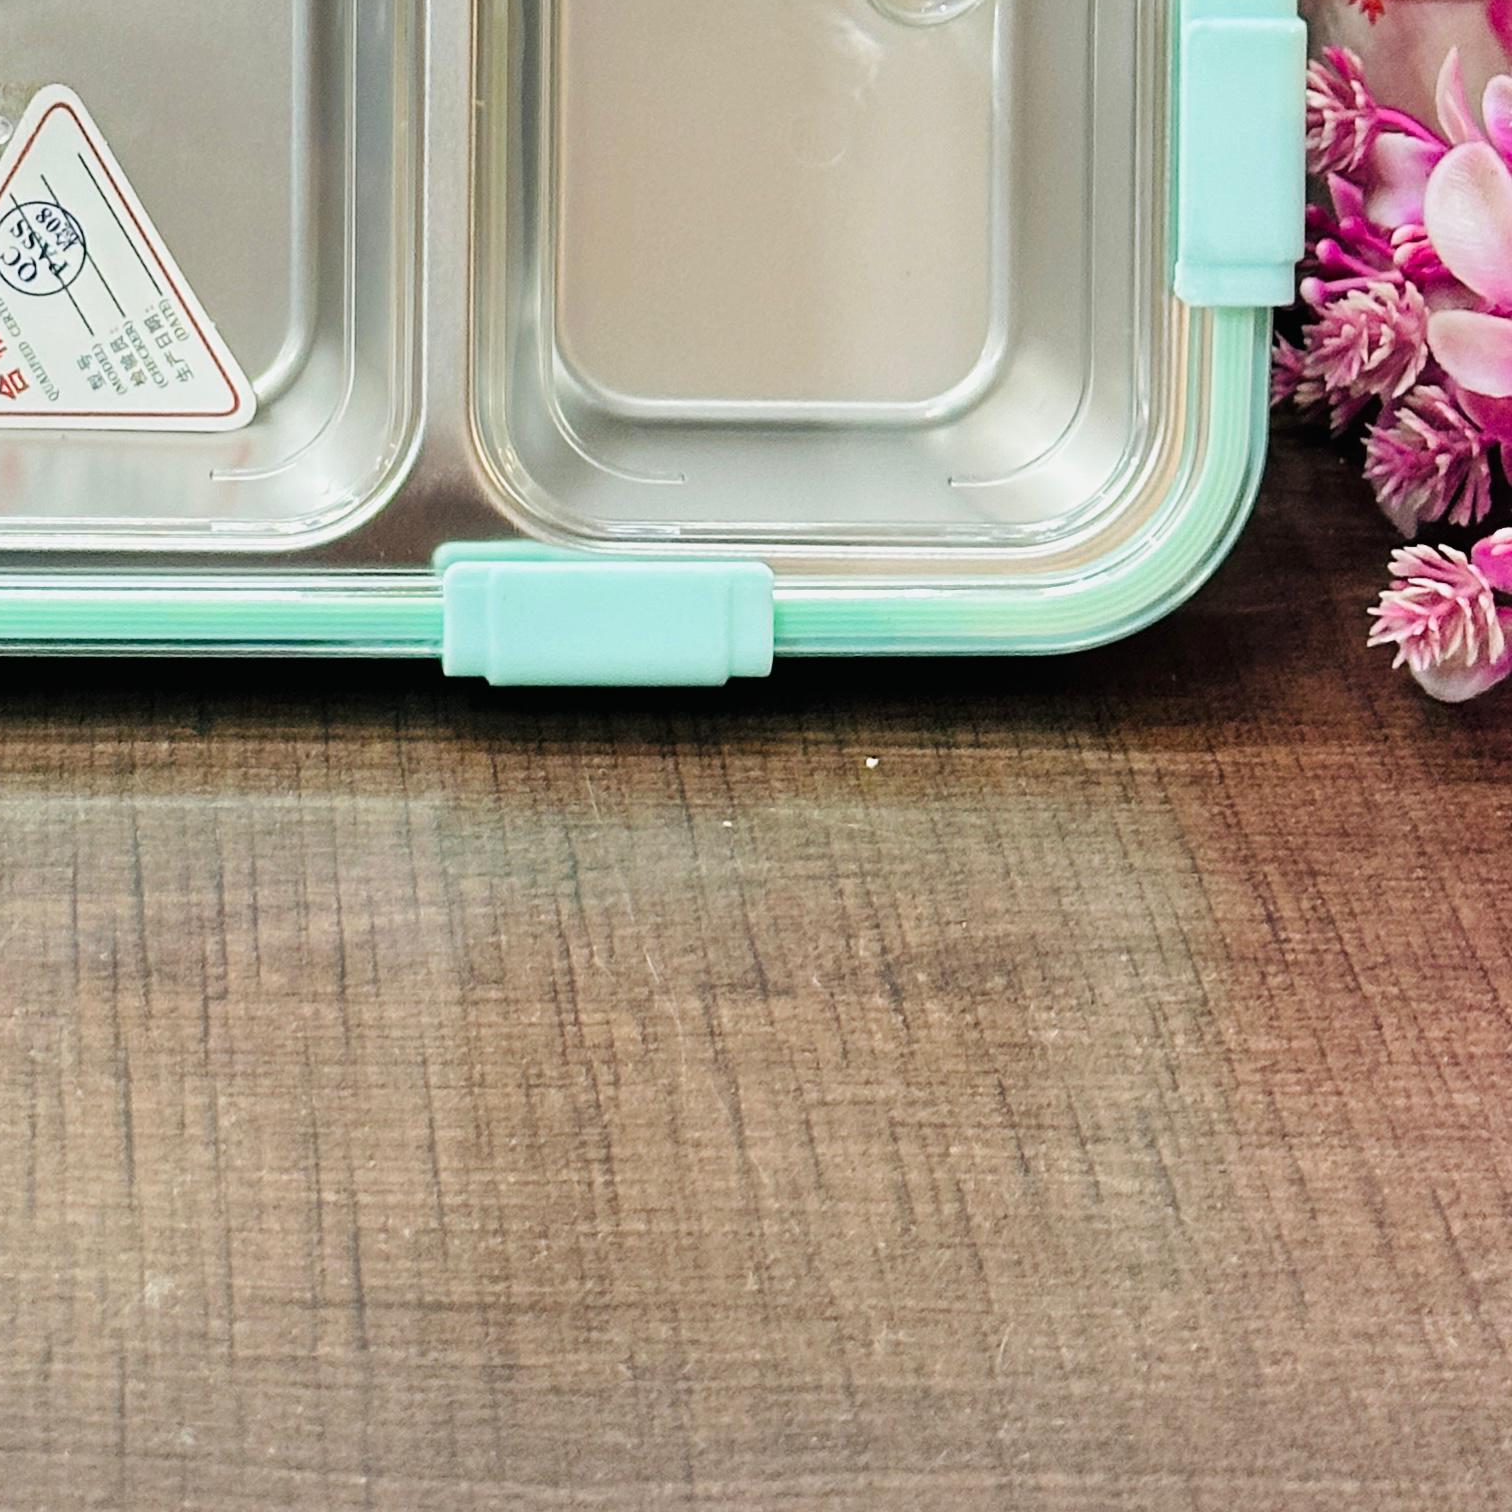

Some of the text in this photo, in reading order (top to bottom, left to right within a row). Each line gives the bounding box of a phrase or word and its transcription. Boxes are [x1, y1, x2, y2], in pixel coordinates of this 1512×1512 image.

[0, 246, 37, 282] QC
[9, 220, 69, 276] PASS
[158, 298, 191, 342] (DATE)
[18, 341, 60, 402] QUALIFIED
[76, 354, 106, 390] 型号
[92, 343, 128, 395] (MODEL)
[123, 320, 169, 388] (CHECKER)
